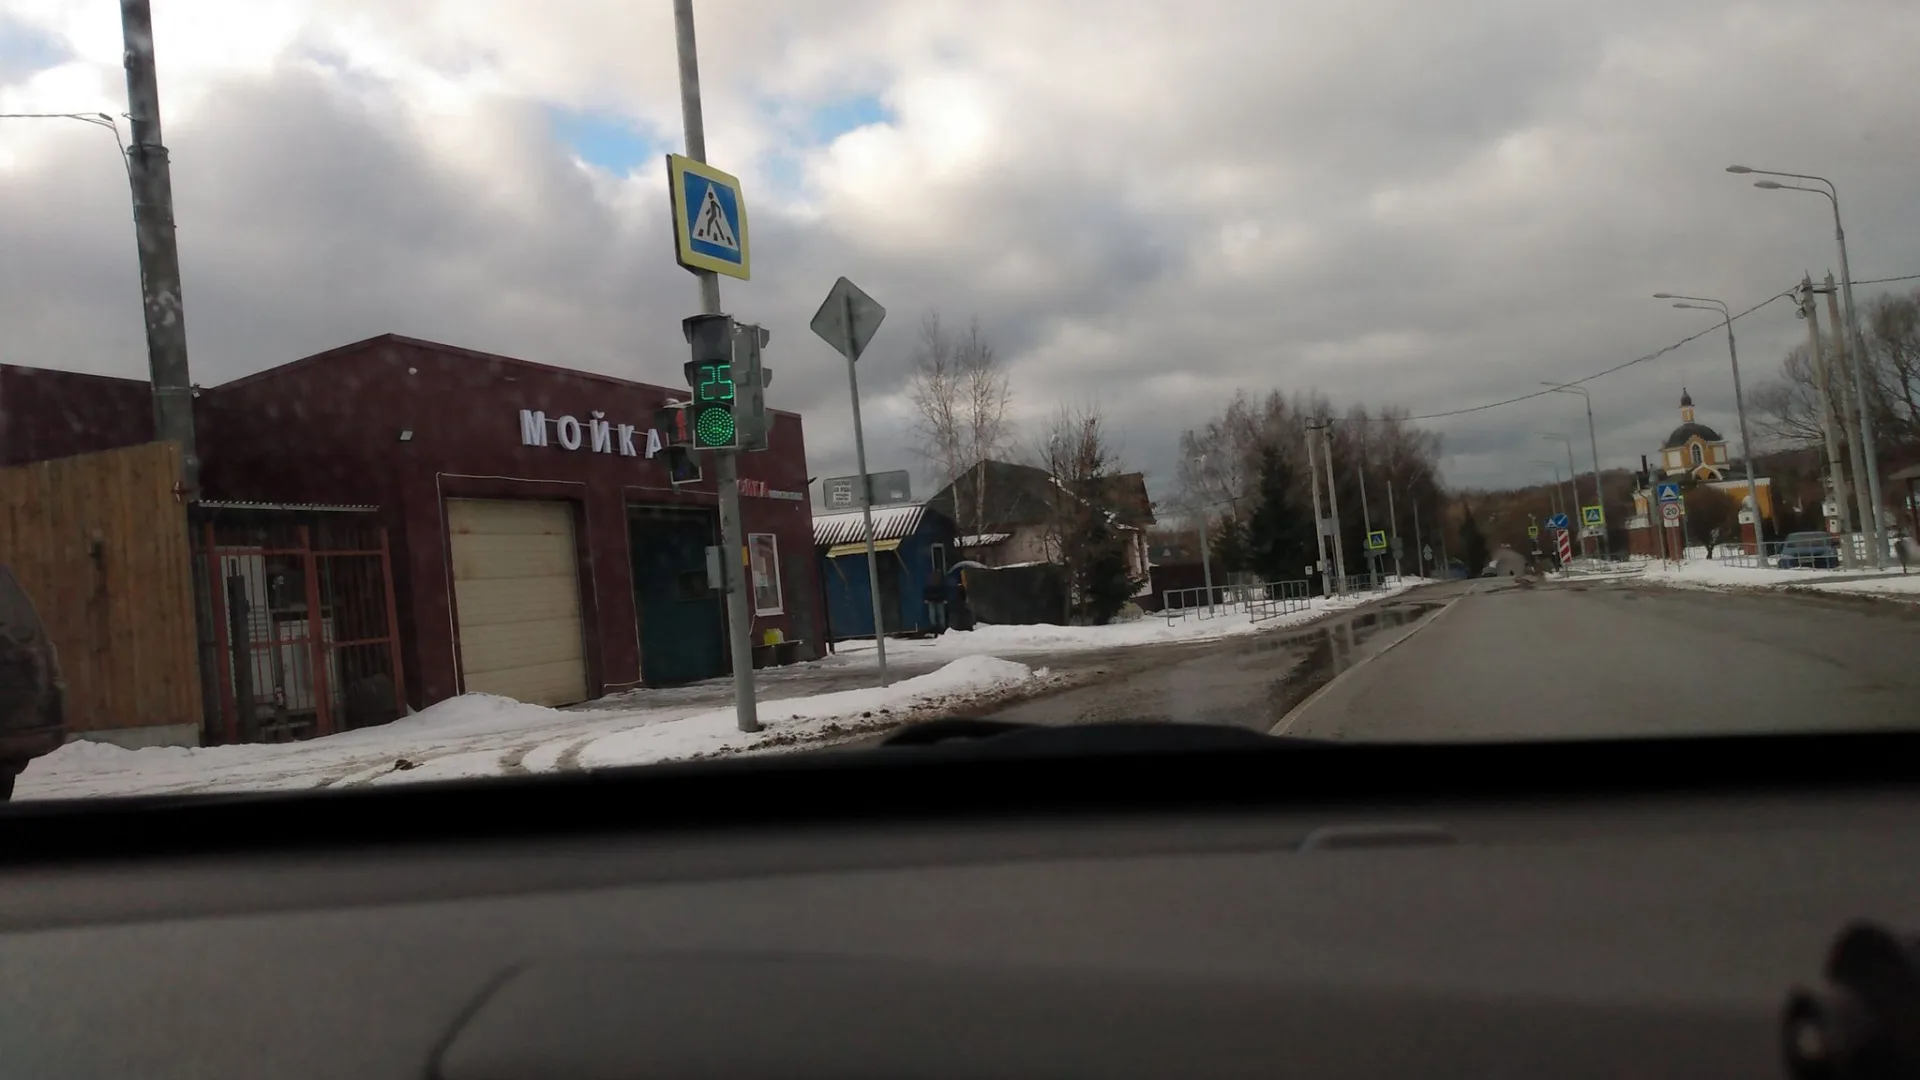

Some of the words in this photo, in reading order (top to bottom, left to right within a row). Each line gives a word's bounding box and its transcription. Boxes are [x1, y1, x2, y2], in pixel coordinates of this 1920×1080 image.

[701, 365, 734, 400] 25
[519, 409, 662, 459] МОЙКА
[1665, 507, 1677, 516] 20
